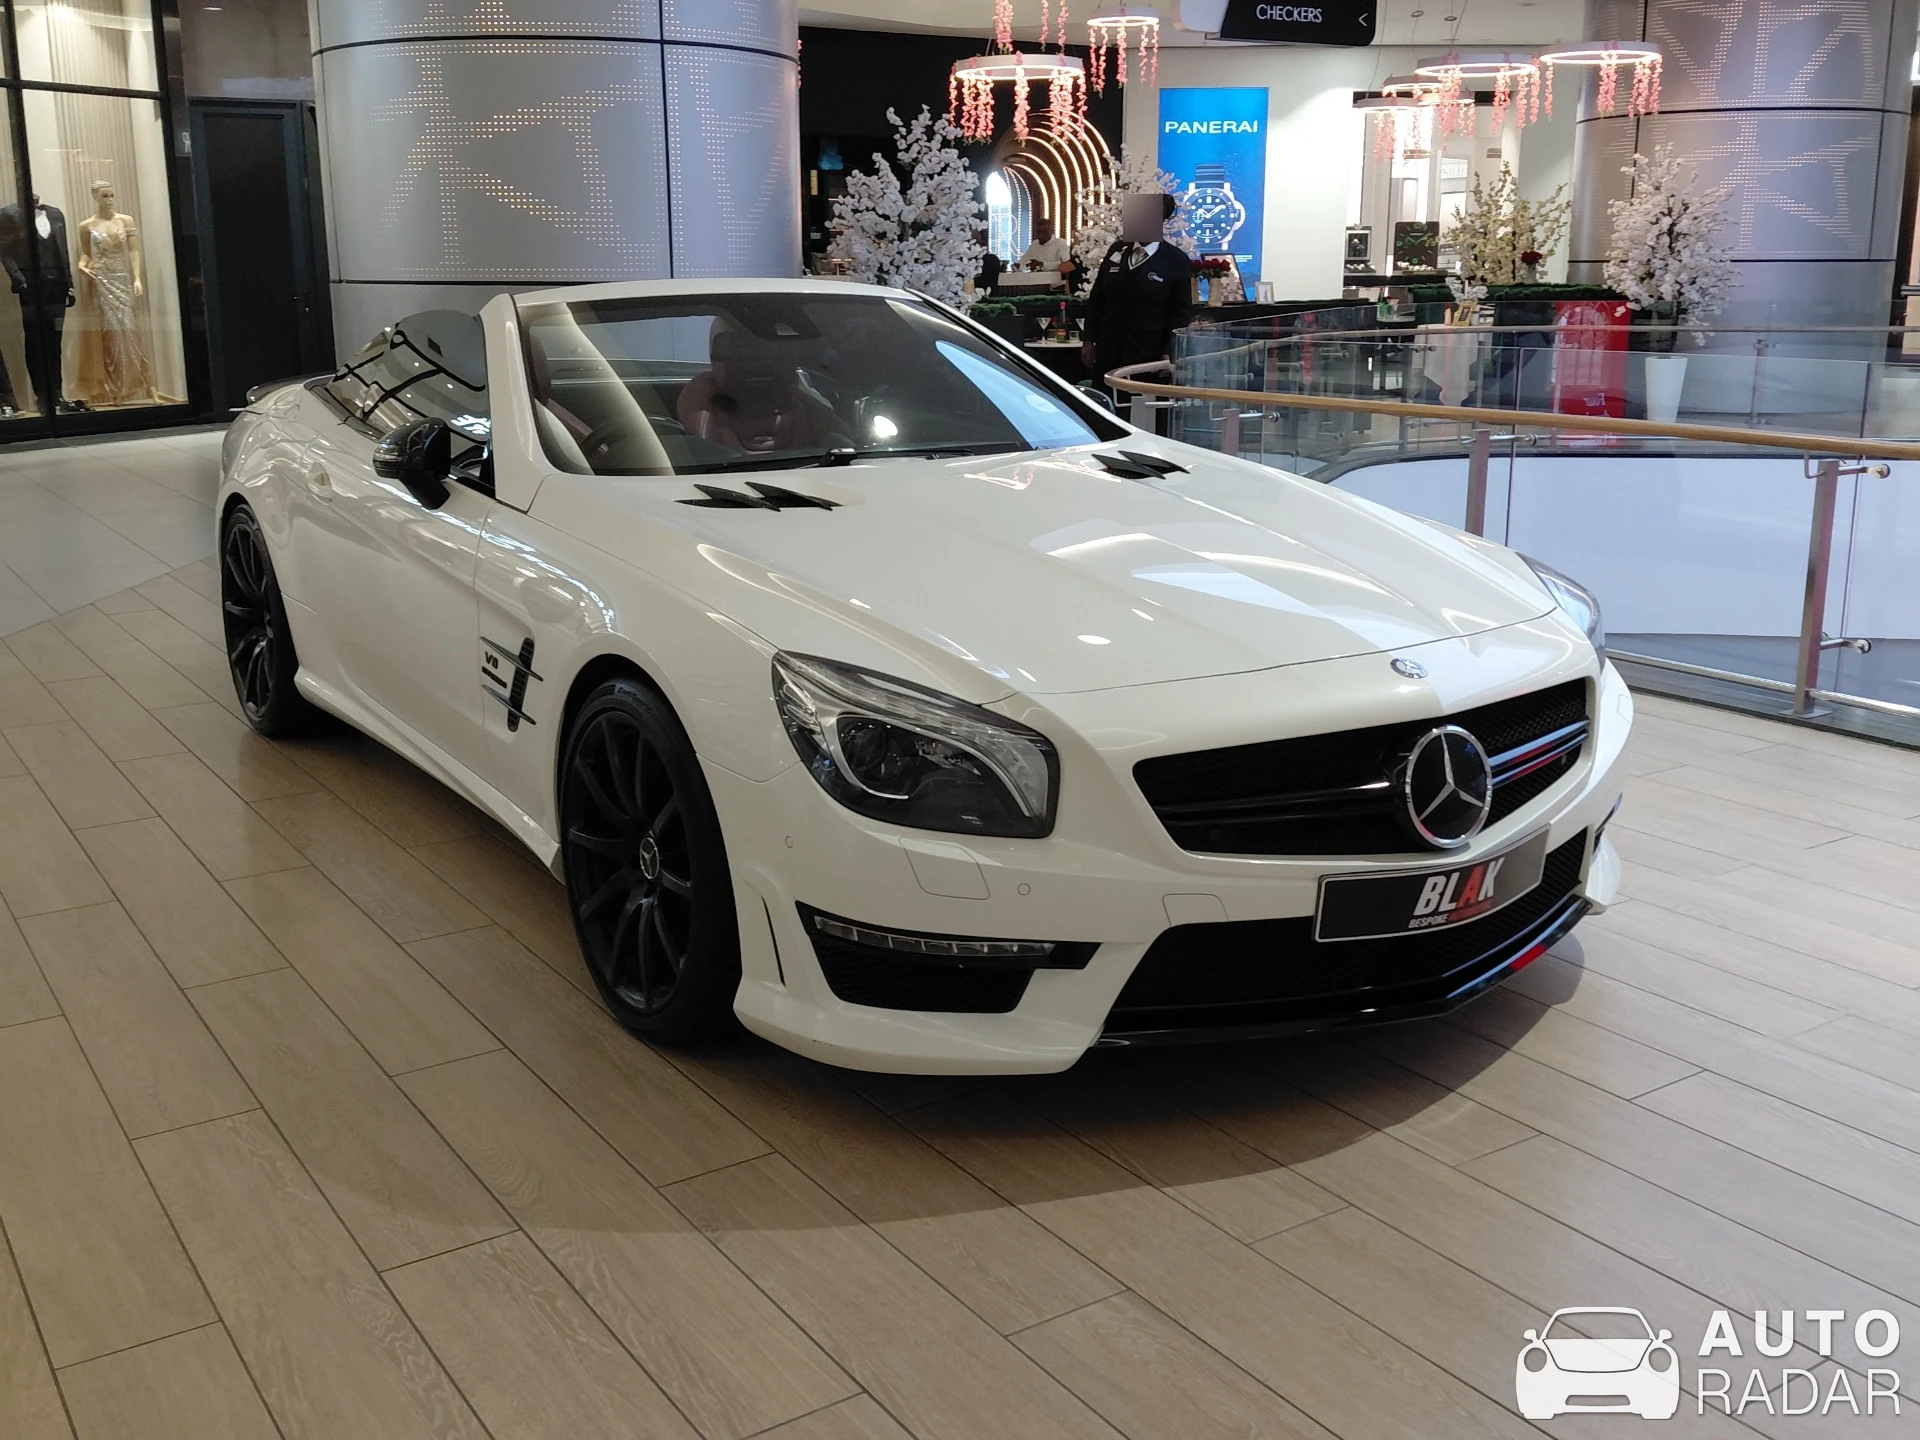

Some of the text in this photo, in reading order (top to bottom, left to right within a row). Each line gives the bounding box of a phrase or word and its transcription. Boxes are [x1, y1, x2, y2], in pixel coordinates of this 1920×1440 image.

[1256, 4, 1323, 23] CHECKERS
[1164, 120, 1259, 134] PANERAI
[1413, 857, 1505, 916] BLAK
[1408, 913, 1450, 929] BESPOKE
